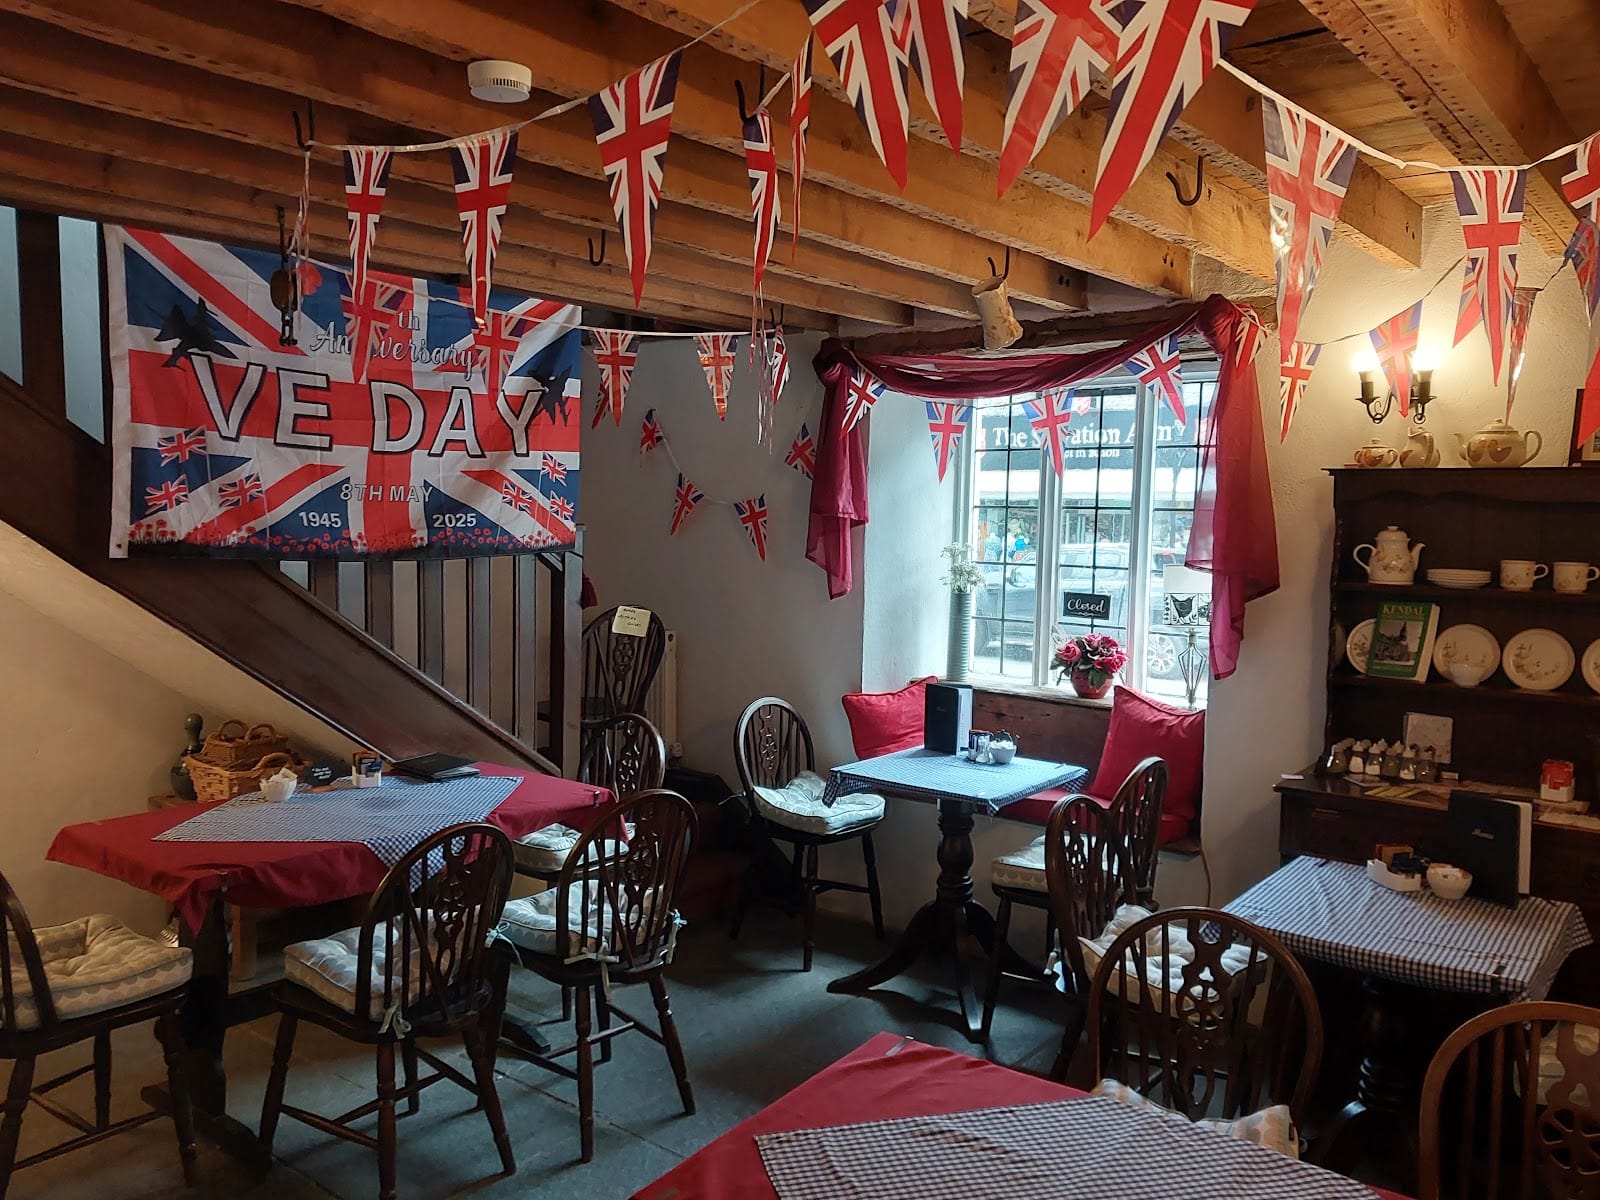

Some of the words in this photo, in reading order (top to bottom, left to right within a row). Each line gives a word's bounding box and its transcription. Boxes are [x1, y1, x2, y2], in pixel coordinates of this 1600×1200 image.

[310, 321, 474, 381] Anversary
[189, 352, 334, 452] VE
[369, 381, 546, 458] DAY
[992, 427, 1028, 448] The
[1031, 422, 1121, 448] Sation
[1088, 449, 1120, 458] acion
[340, 483, 383, 502] 8TH
[389, 485, 433, 503] MAY
[299, 511, 342, 528] 1945
[432, 513, 477, 528] 2025
[1067, 598, 1106, 613] Closed
[1382, 605, 1425, 615] KENDAL
